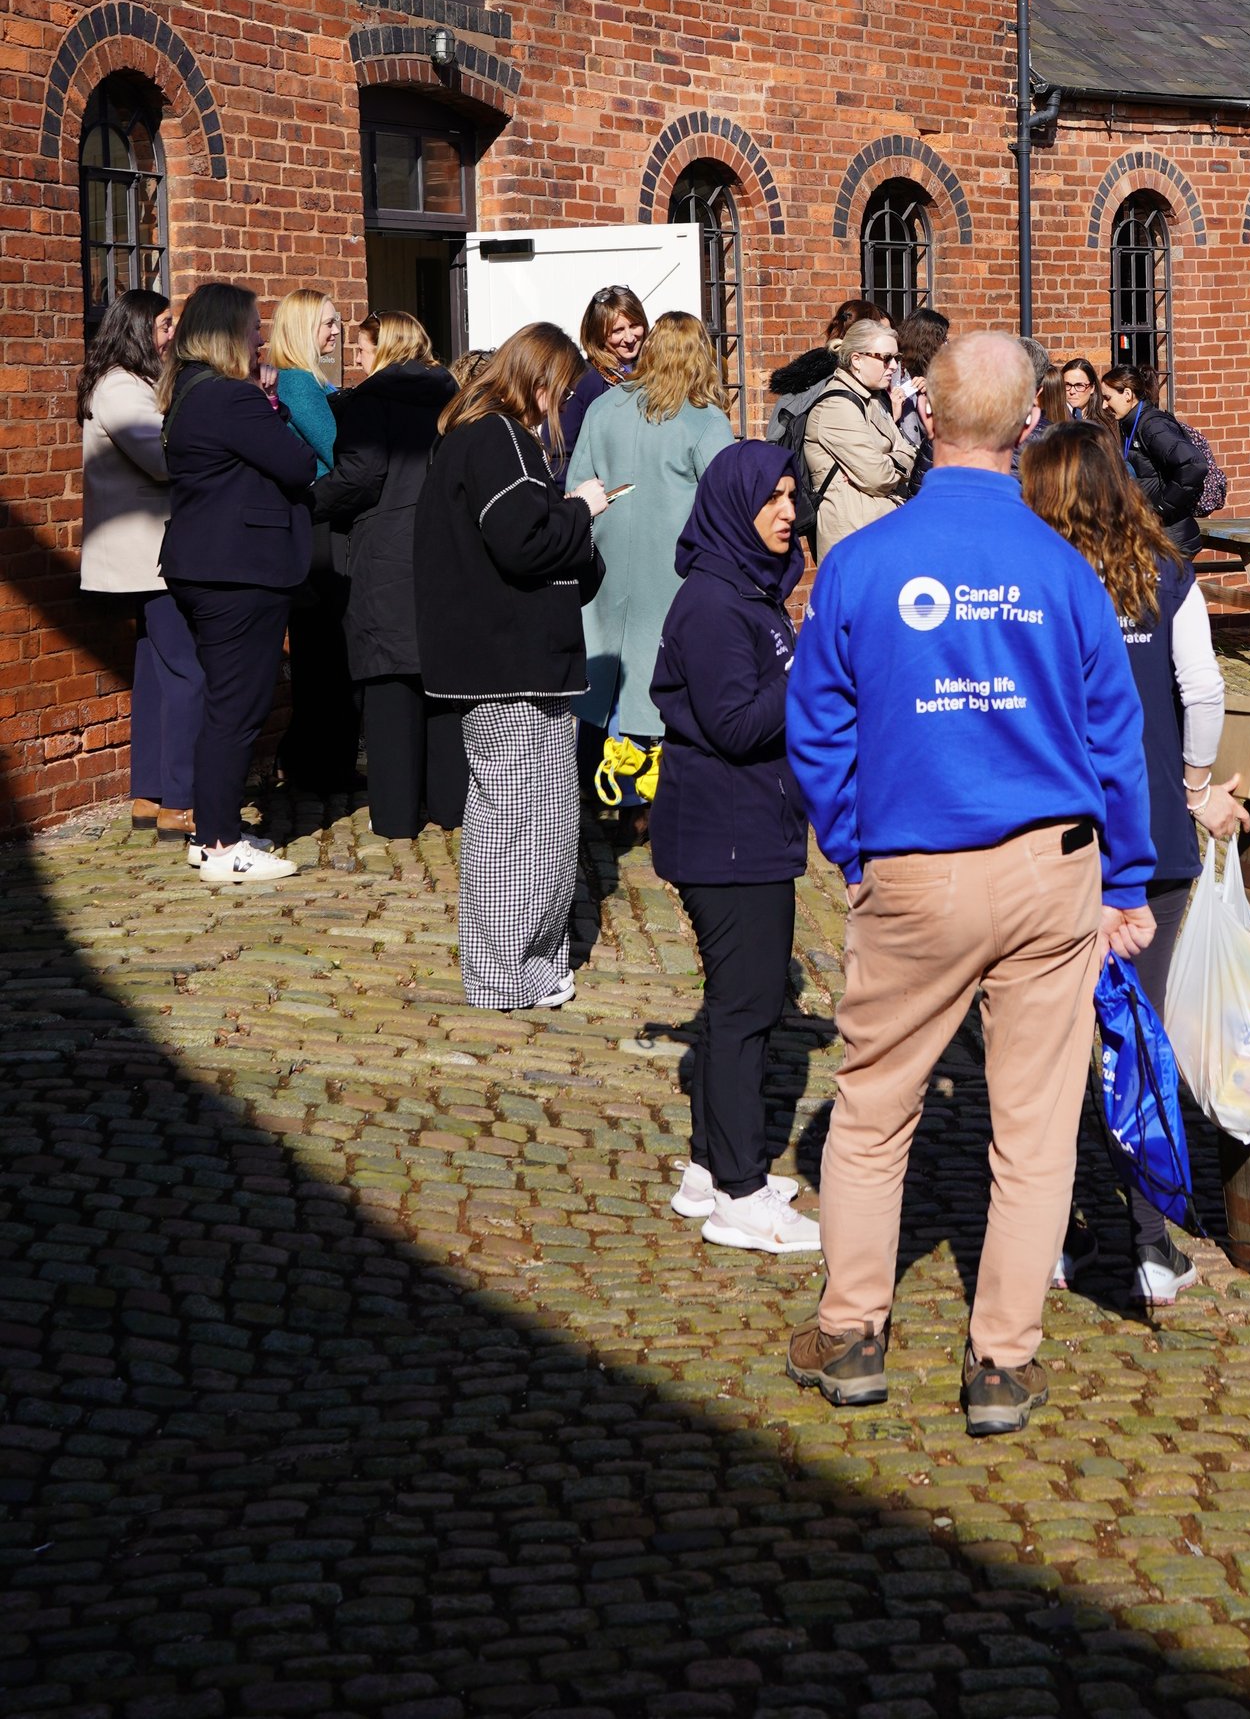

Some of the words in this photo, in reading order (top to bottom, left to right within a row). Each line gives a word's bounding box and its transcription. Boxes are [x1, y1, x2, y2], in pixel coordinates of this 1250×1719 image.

[954, 584, 1004, 603] Canal
[1007, 585, 1021, 603] &
[955, 603, 998, 621] River
[1000, 603, 1044, 625] Trust
[935, 677, 990, 697] Making
[993, 676, 1016, 693] life
[915, 696, 967, 714] better
[968, 695, 990, 713] by
[991, 695, 1027, 711] water
